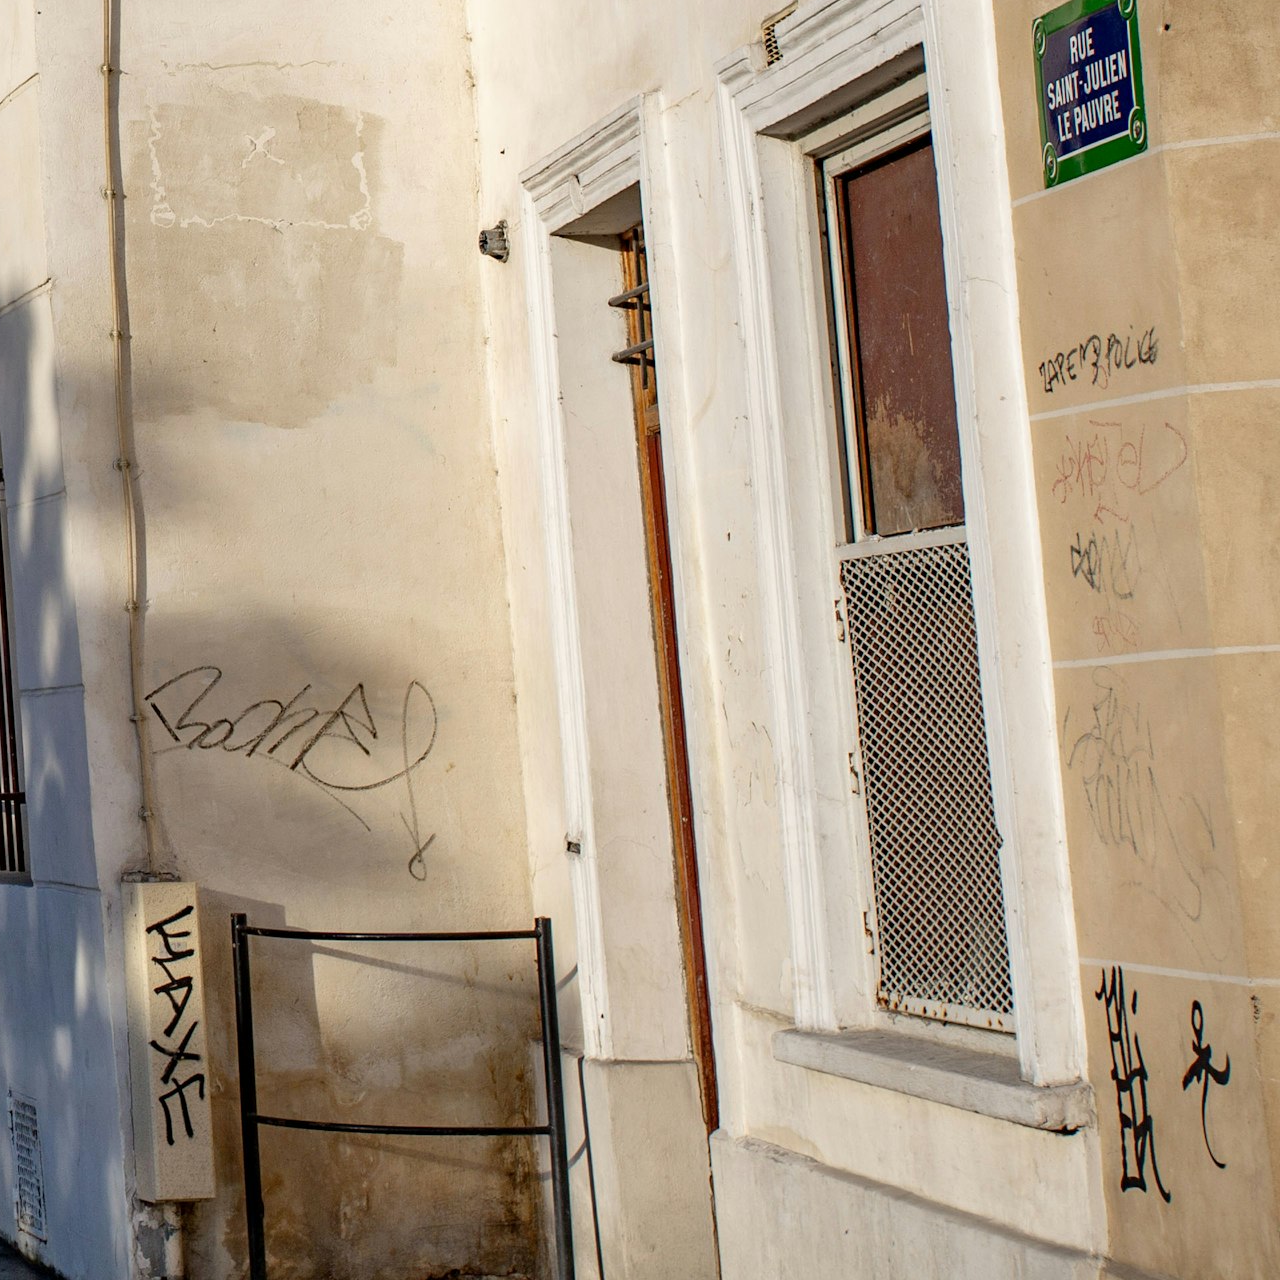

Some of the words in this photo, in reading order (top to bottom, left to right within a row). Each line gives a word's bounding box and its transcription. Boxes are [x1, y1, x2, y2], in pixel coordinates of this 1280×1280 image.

[1068, 27, 1095, 65] RUE
[1047, 49, 1128, 111] SAINT-JULIEN
[1057, 114, 1072, 142] LE
[1073, 90, 1122, 137] PAUVRE
